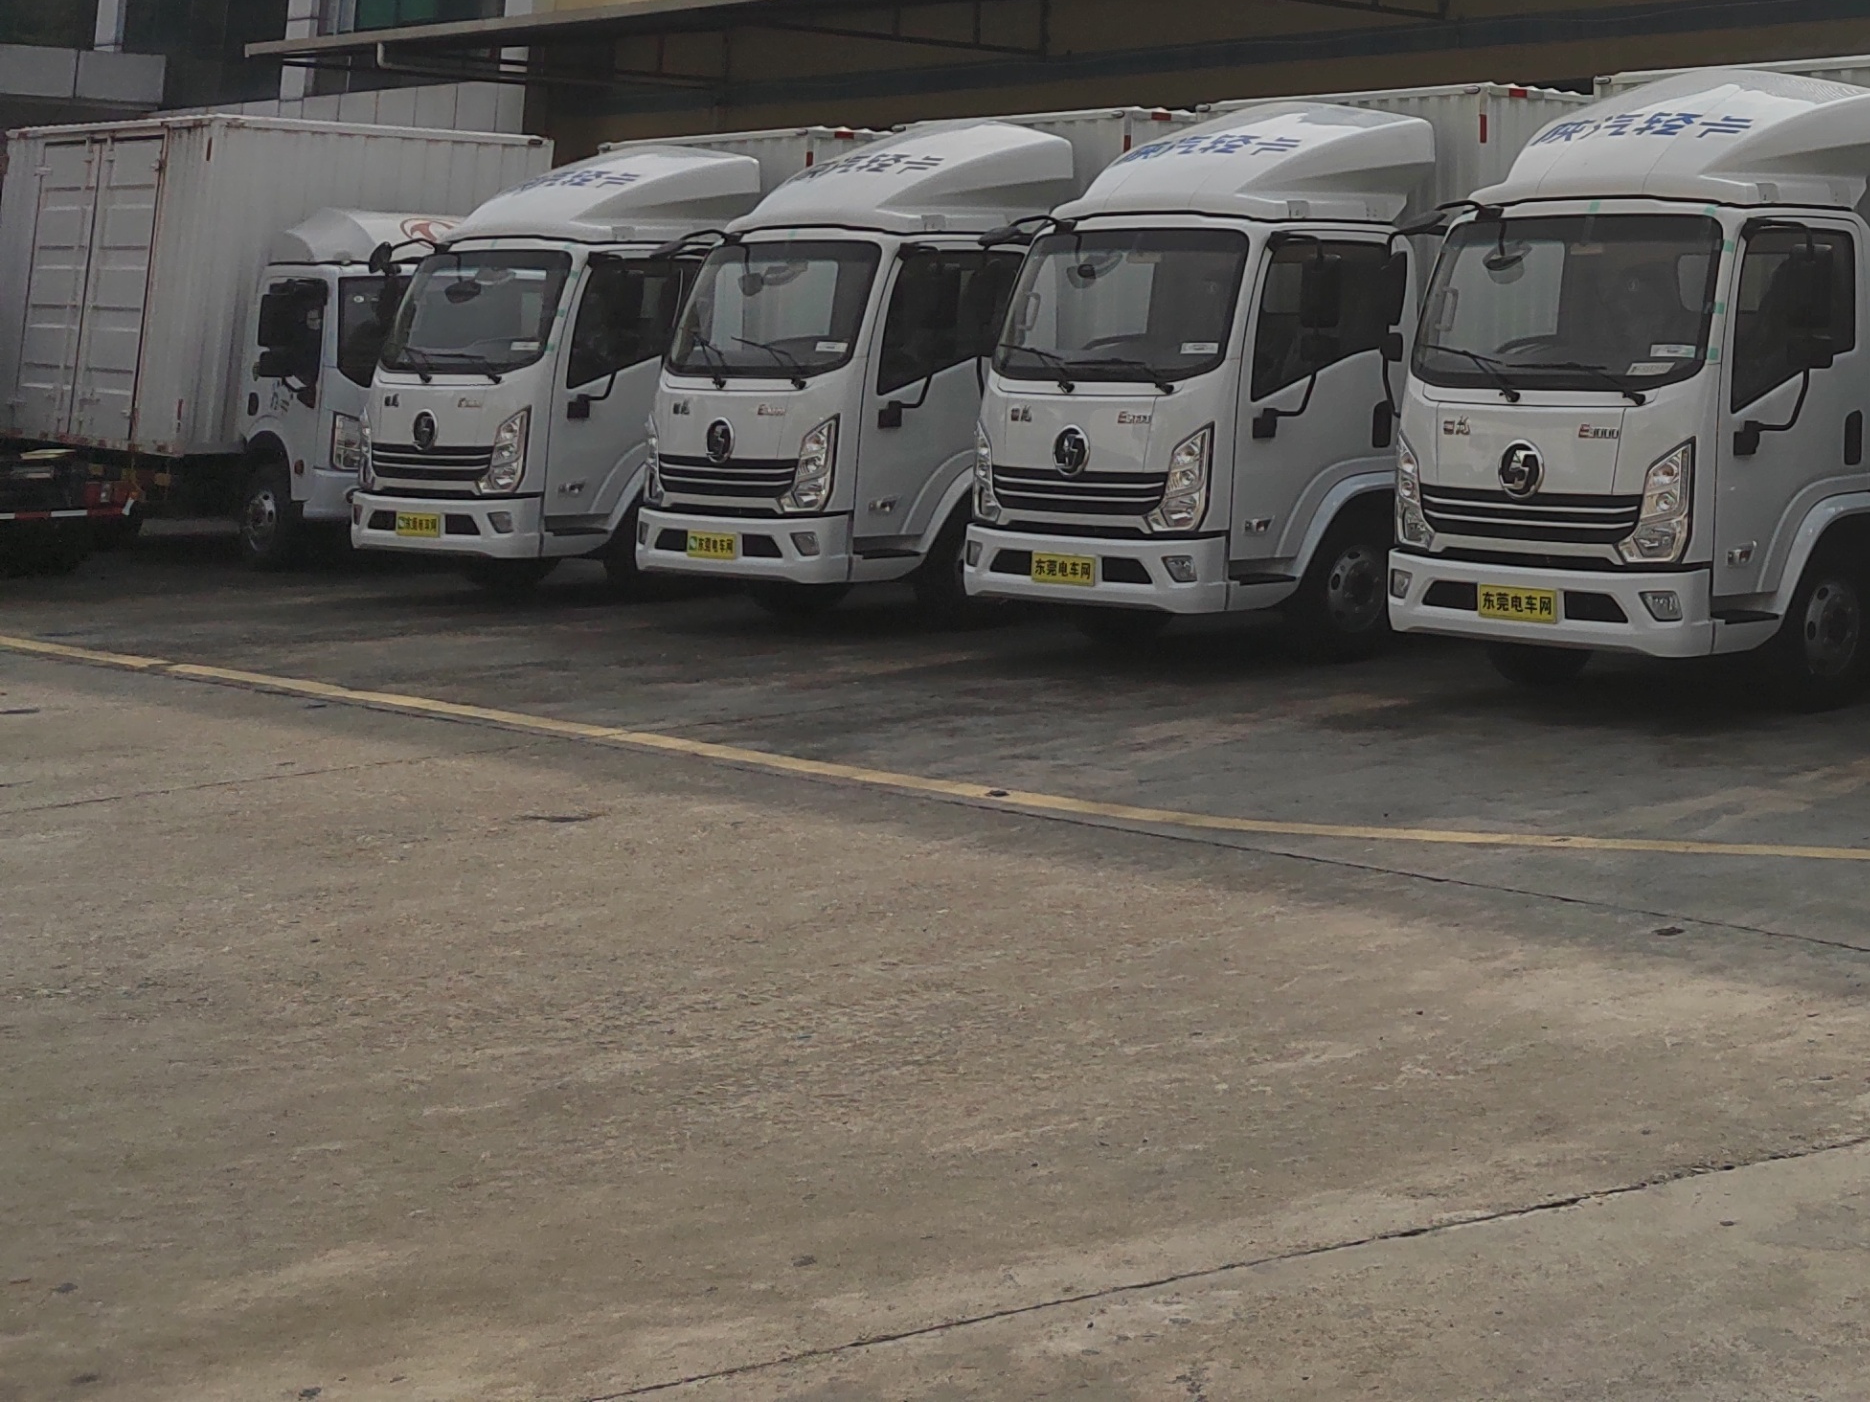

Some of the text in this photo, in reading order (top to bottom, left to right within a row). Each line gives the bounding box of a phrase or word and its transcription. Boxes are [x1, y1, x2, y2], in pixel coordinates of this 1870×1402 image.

[1035, 558, 1091, 581] 东莞电车网
[1482, 591, 1552, 616] 东莞电车网
